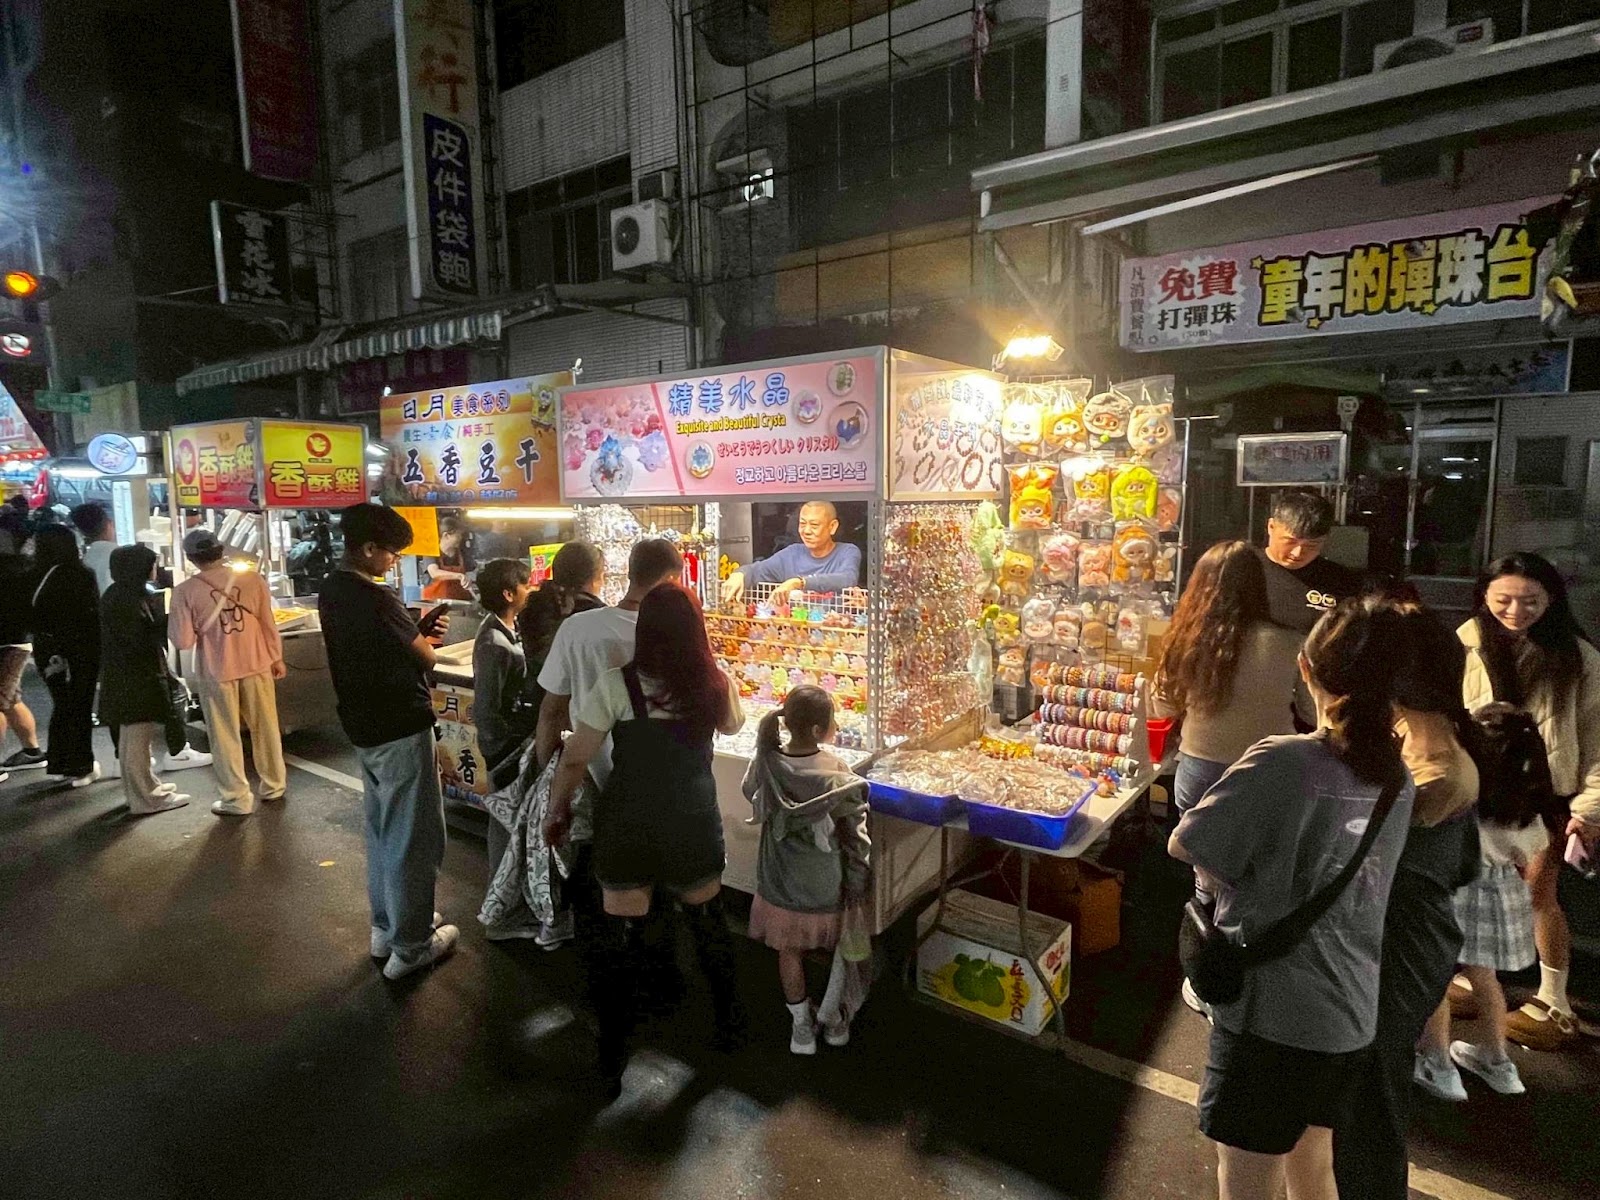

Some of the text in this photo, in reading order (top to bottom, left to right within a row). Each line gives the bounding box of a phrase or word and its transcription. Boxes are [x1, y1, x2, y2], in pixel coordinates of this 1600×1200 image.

[1157, 260, 1238, 305] 免費
[1259, 223, 1538, 326] 童年的彈珠台
[1157, 301, 1237, 331] 打彈珠
[403, 394, 445, 420] 日月
[668, 371, 790, 417] 精美水晶
[675, 412, 787, 437] Exquisite and Beautiful Crysta
[797, 434, 840, 453] クリスタル
[198, 442, 254, 493] 香酥雞
[269, 460, 361, 498] 香酥雞
[402, 437, 541, 486] 五香豆干
[735, 461, 867, 485] 정교하고 아름다운 크리스탈
